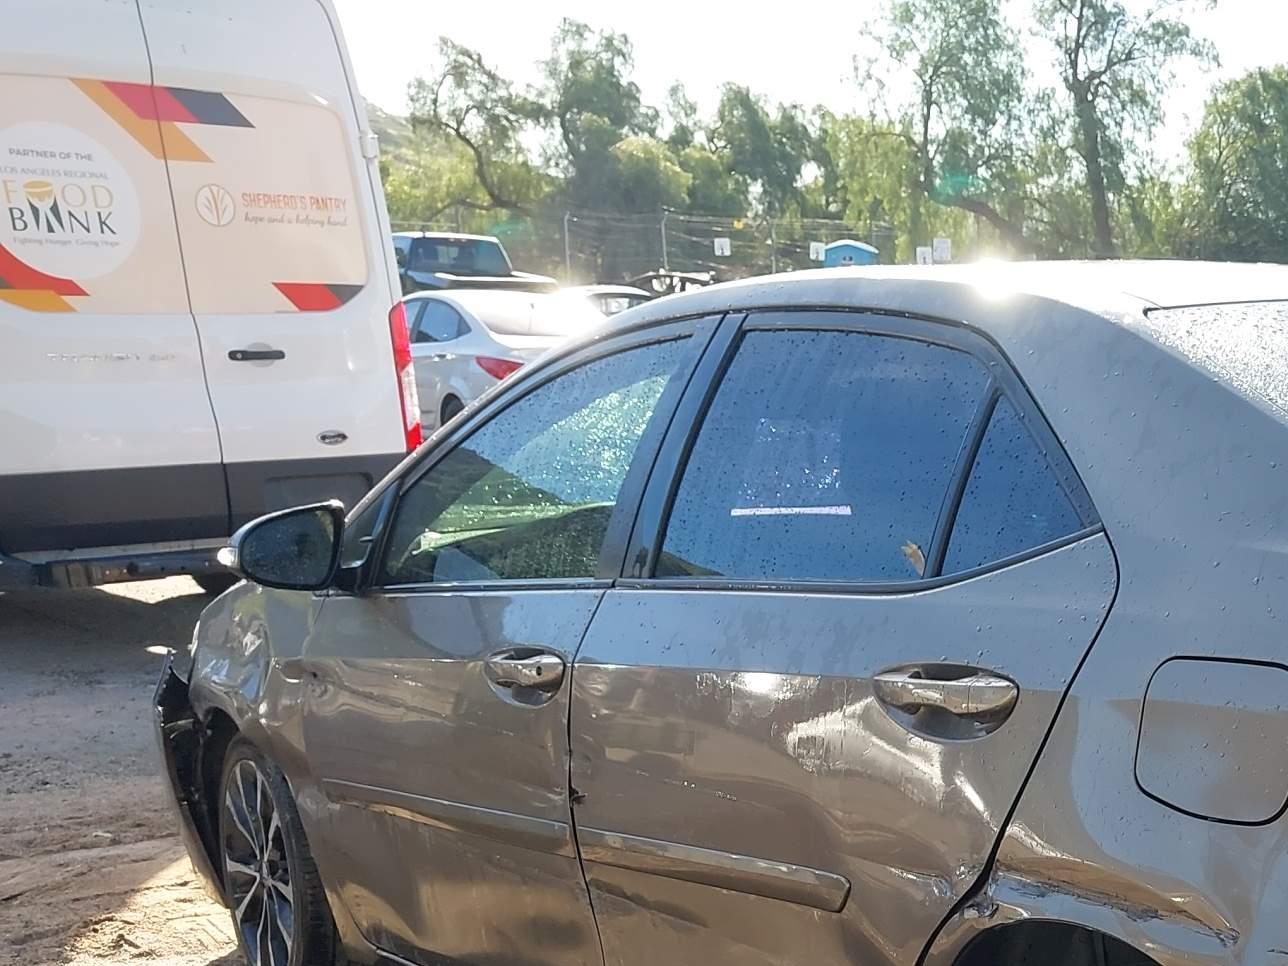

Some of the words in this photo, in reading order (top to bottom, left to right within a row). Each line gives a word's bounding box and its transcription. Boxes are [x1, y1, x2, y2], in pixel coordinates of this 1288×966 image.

[8, 148, 56, 160] PARTNER
[59, 151, 73, 160] OF
[75, 152, 94, 161] THE
[20, 168, 61, 177] ANGELES
[63, 170, 109, 179] REGIONAL
[241, 192, 306, 210] SHEPHERD'S
[310, 196, 346, 210] PANTRY
